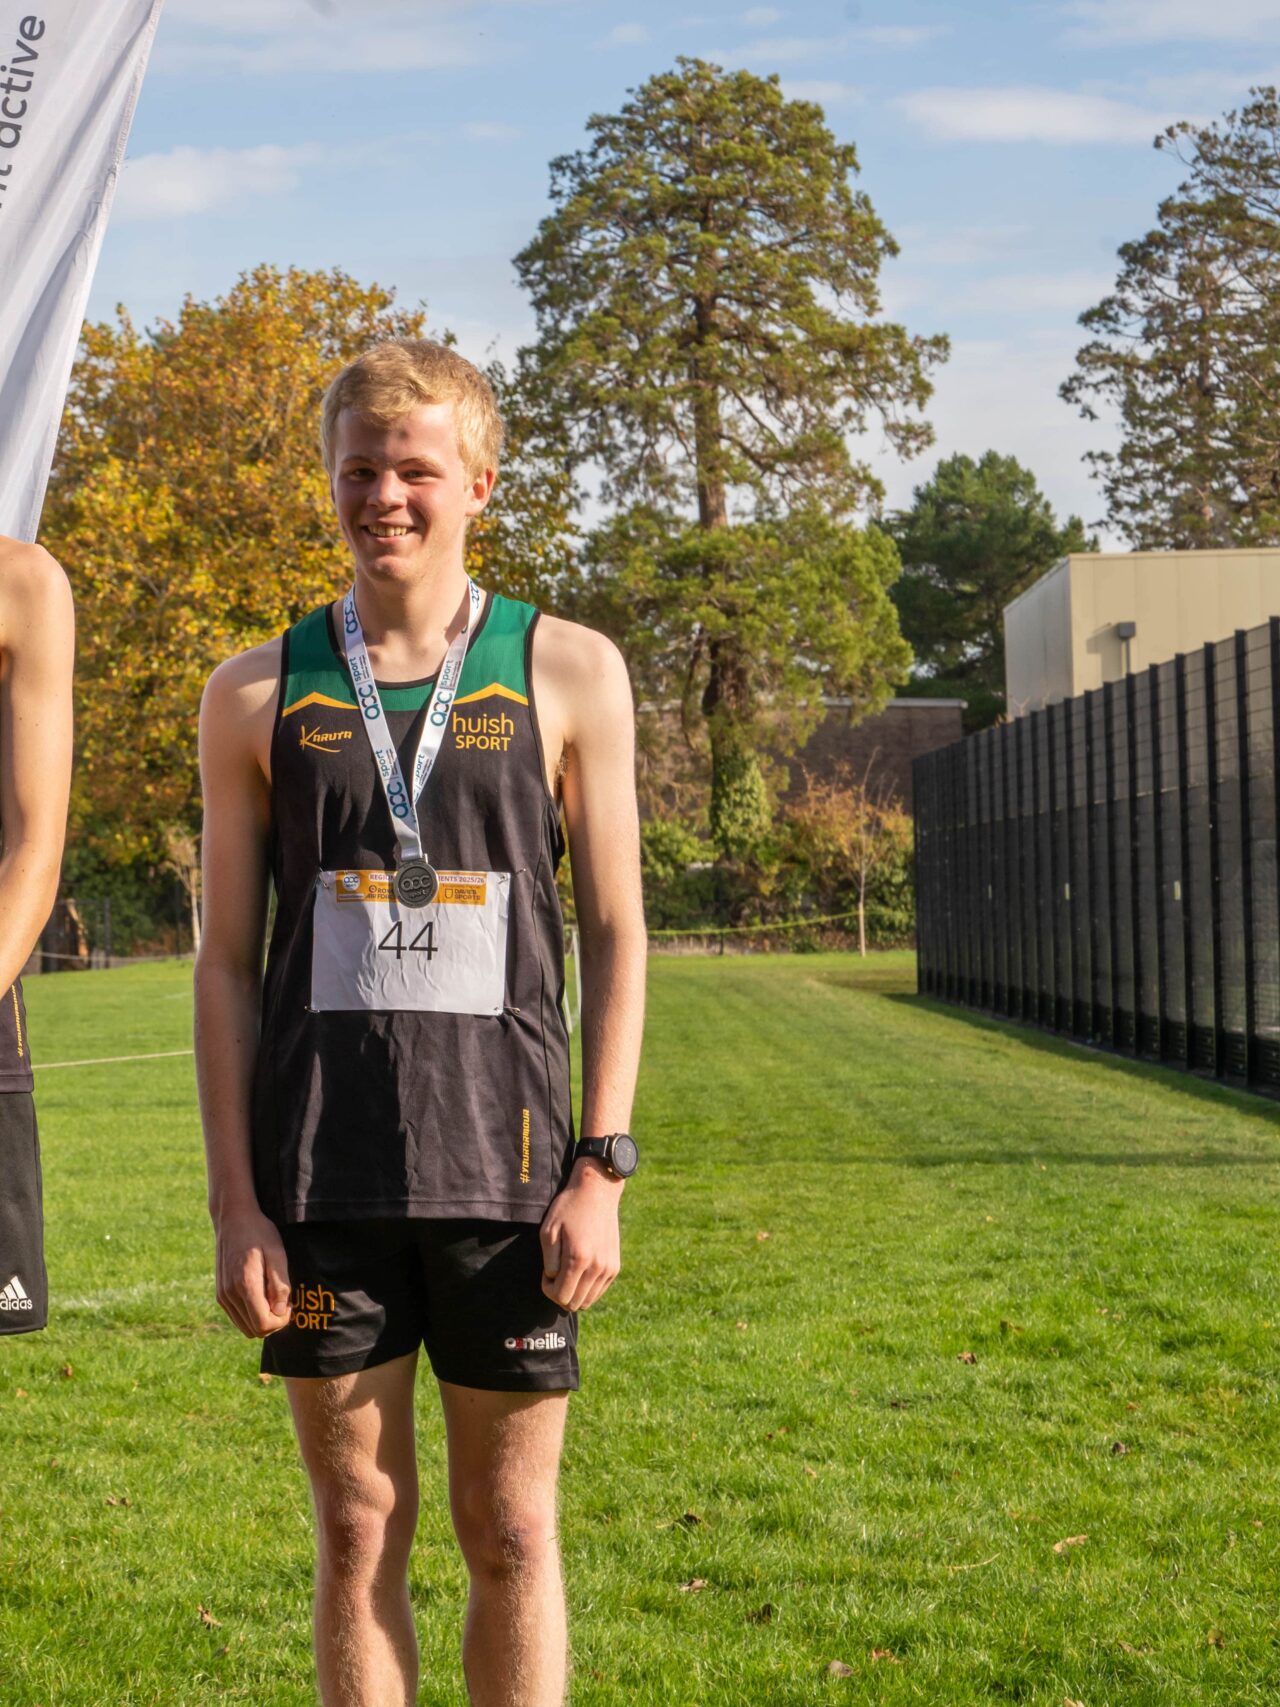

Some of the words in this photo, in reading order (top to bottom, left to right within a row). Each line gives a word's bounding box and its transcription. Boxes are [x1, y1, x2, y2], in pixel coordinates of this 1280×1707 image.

[350, 656, 361, 681] sport
[453, 711, 514, 735] huish
[456, 735, 511, 752] SPORT
[375, 749, 391, 777] sport
[459, 876, 484, 884] 2025/26
[378, 921, 438, 960] 44
[291, 1312, 332, 1329] ORT
